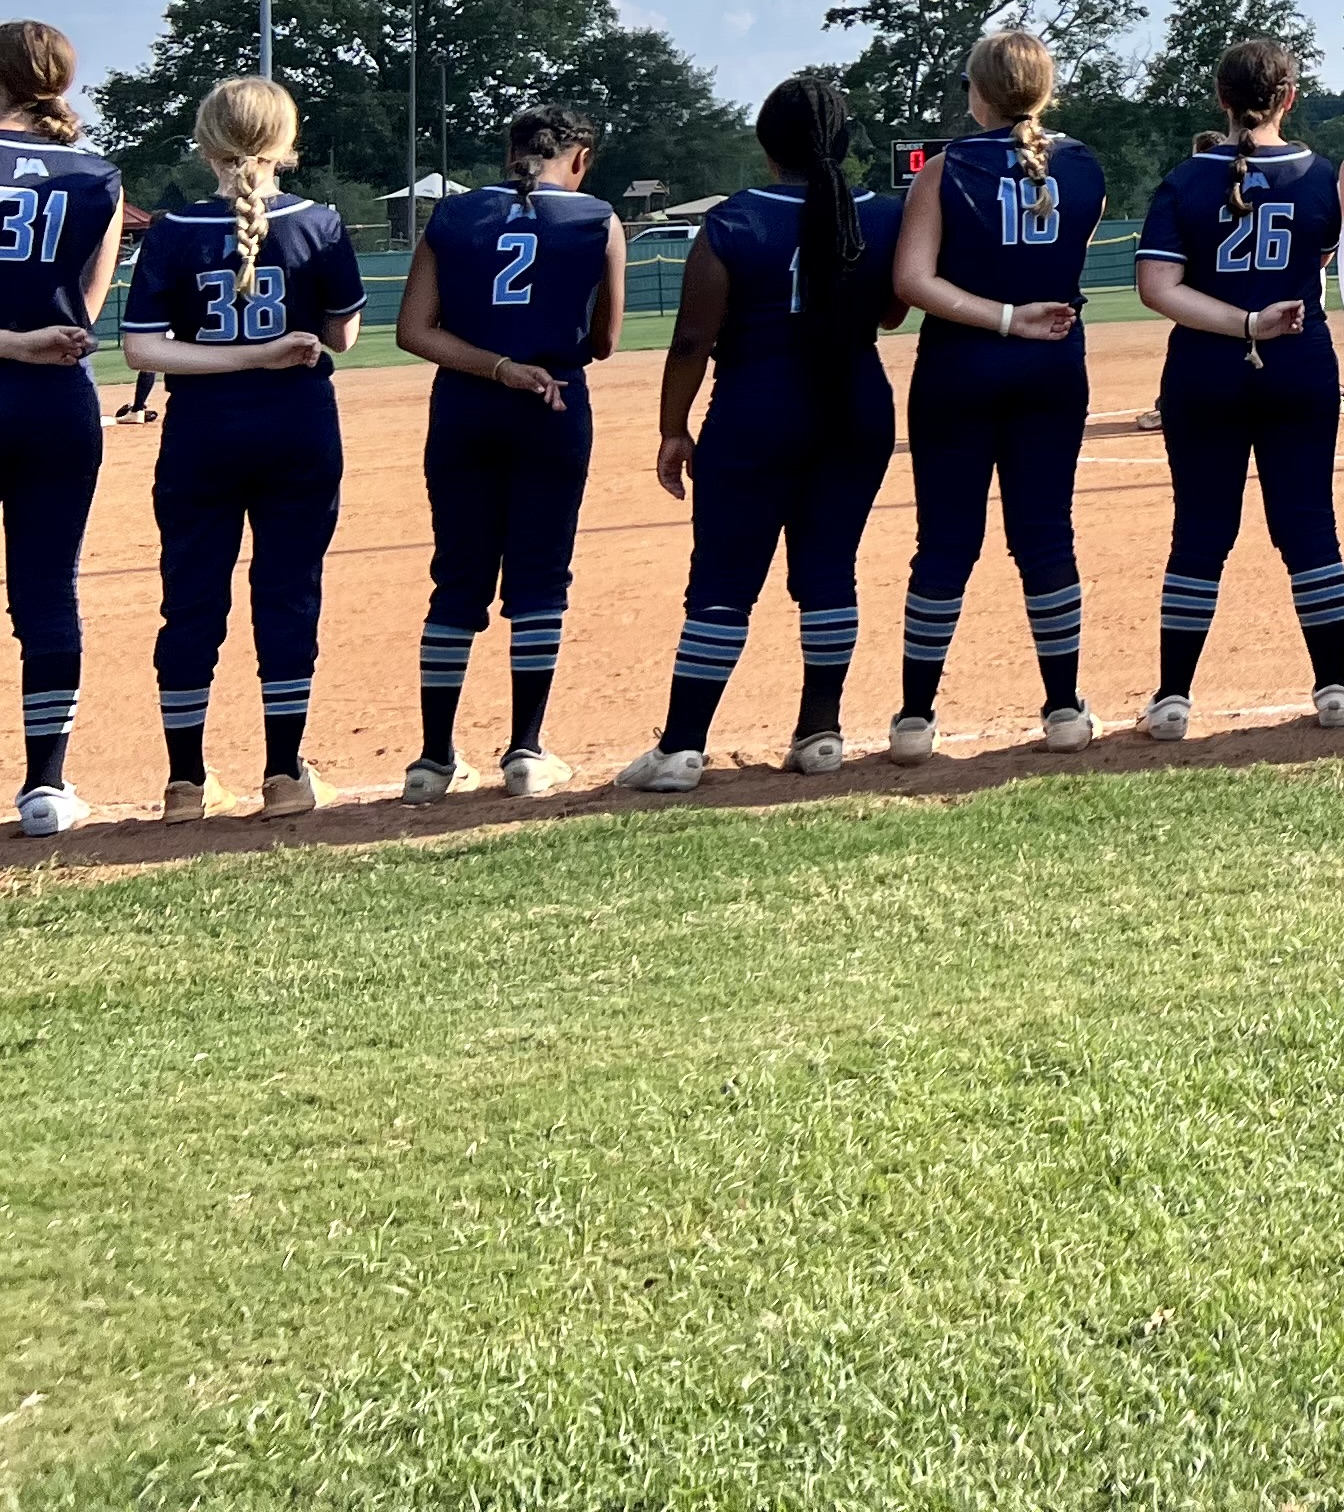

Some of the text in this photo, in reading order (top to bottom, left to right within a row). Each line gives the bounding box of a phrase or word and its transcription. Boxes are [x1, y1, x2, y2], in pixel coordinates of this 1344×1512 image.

[895, 143, 924, 151] GUEST
[910, 151, 924, 172] 0
[0, 186, 68, 262] 31
[997, 176, 1060, 245] 18
[1216, 202, 1295, 272] 26
[196, 266, 287, 341] 38
[492, 232, 538, 305] 2
